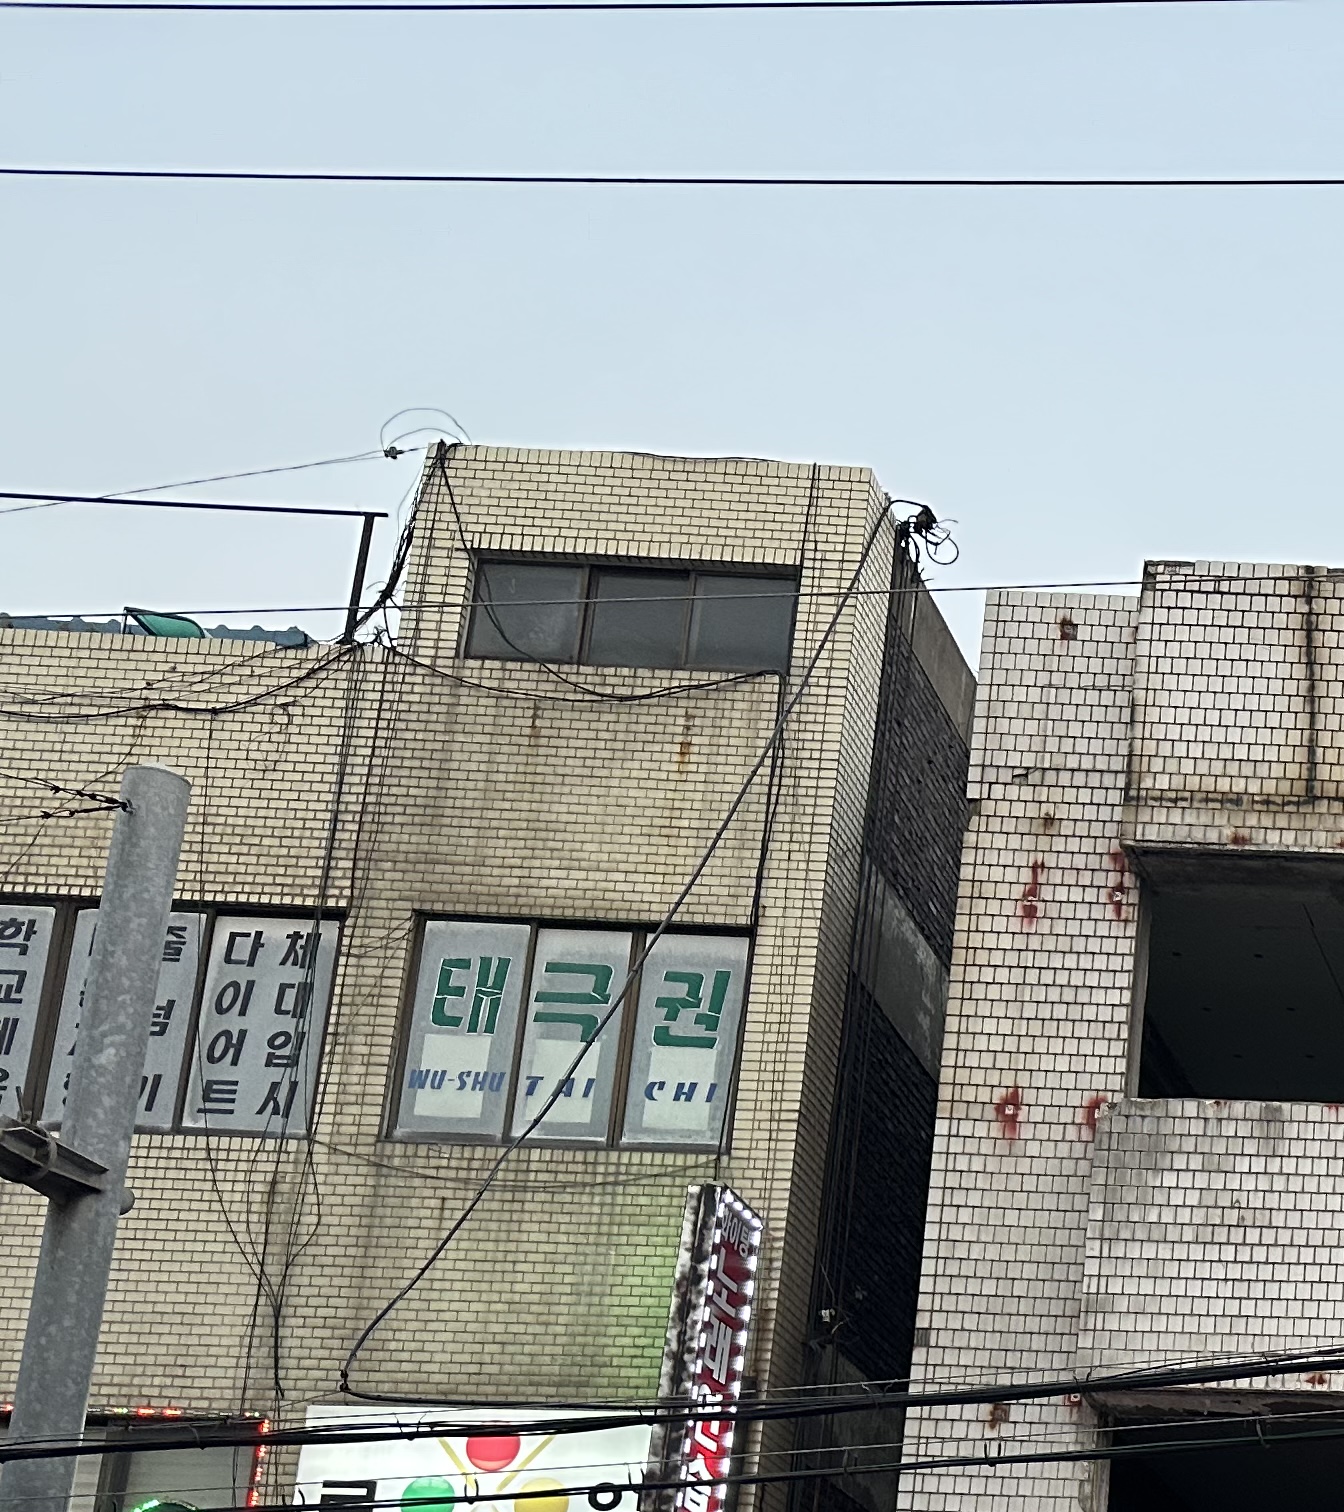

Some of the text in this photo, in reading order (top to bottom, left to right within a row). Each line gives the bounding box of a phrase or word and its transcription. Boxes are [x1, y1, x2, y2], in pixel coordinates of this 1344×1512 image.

[197, 931, 265, 1115] 다이어트
[430, 956, 732, 1050] 태극권
[408, 1069, 718, 1103] WU-SHU TAI CHI
